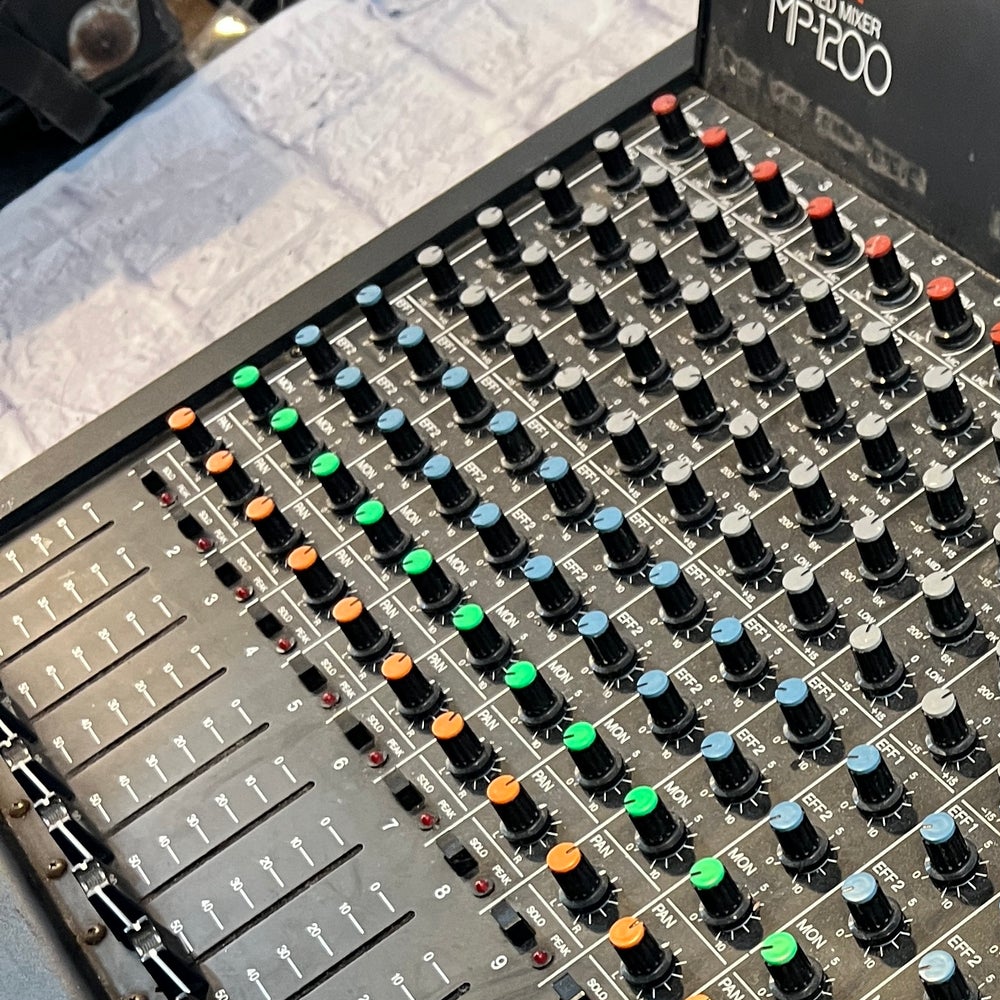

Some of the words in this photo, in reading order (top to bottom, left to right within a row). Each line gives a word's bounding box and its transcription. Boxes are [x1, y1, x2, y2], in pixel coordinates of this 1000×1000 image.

[838, 1, 881, 40] MIXER
[401, 506, 422, 527] MON
[448, 553, 470, 576] MON
[379, 599, 400, 619] PAN
[497, 604, 520, 629] MON
[427, 653, 448, 673] PAN
[924, 667, 945, 685] LOW
[286, 699, 303, 713] 5
[367, 714, 385, 733] SOLO
[478, 710, 500, 732] PAN
[333, 757, 349, 771] 6
[416, 773, 434, 793] SOLO
[532, 770, 555, 792] PAN
[438, 800, 457, 820] PEAK
[382, 818, 400, 831] 7
[469, 837, 489, 858] SOLO
[728, 847, 758, 877] MON
[493, 864, 512, 886] PEAK
[434, 884, 451, 899] 8
[526, 906, 547, 927] SOLO
[651, 903, 679, 930] PAN
[795, 918, 827, 950] MON
[551, 934, 571, 957] PEAK
[491, 954, 508, 971] 9
[586, 977, 609, 1000] SOLO
